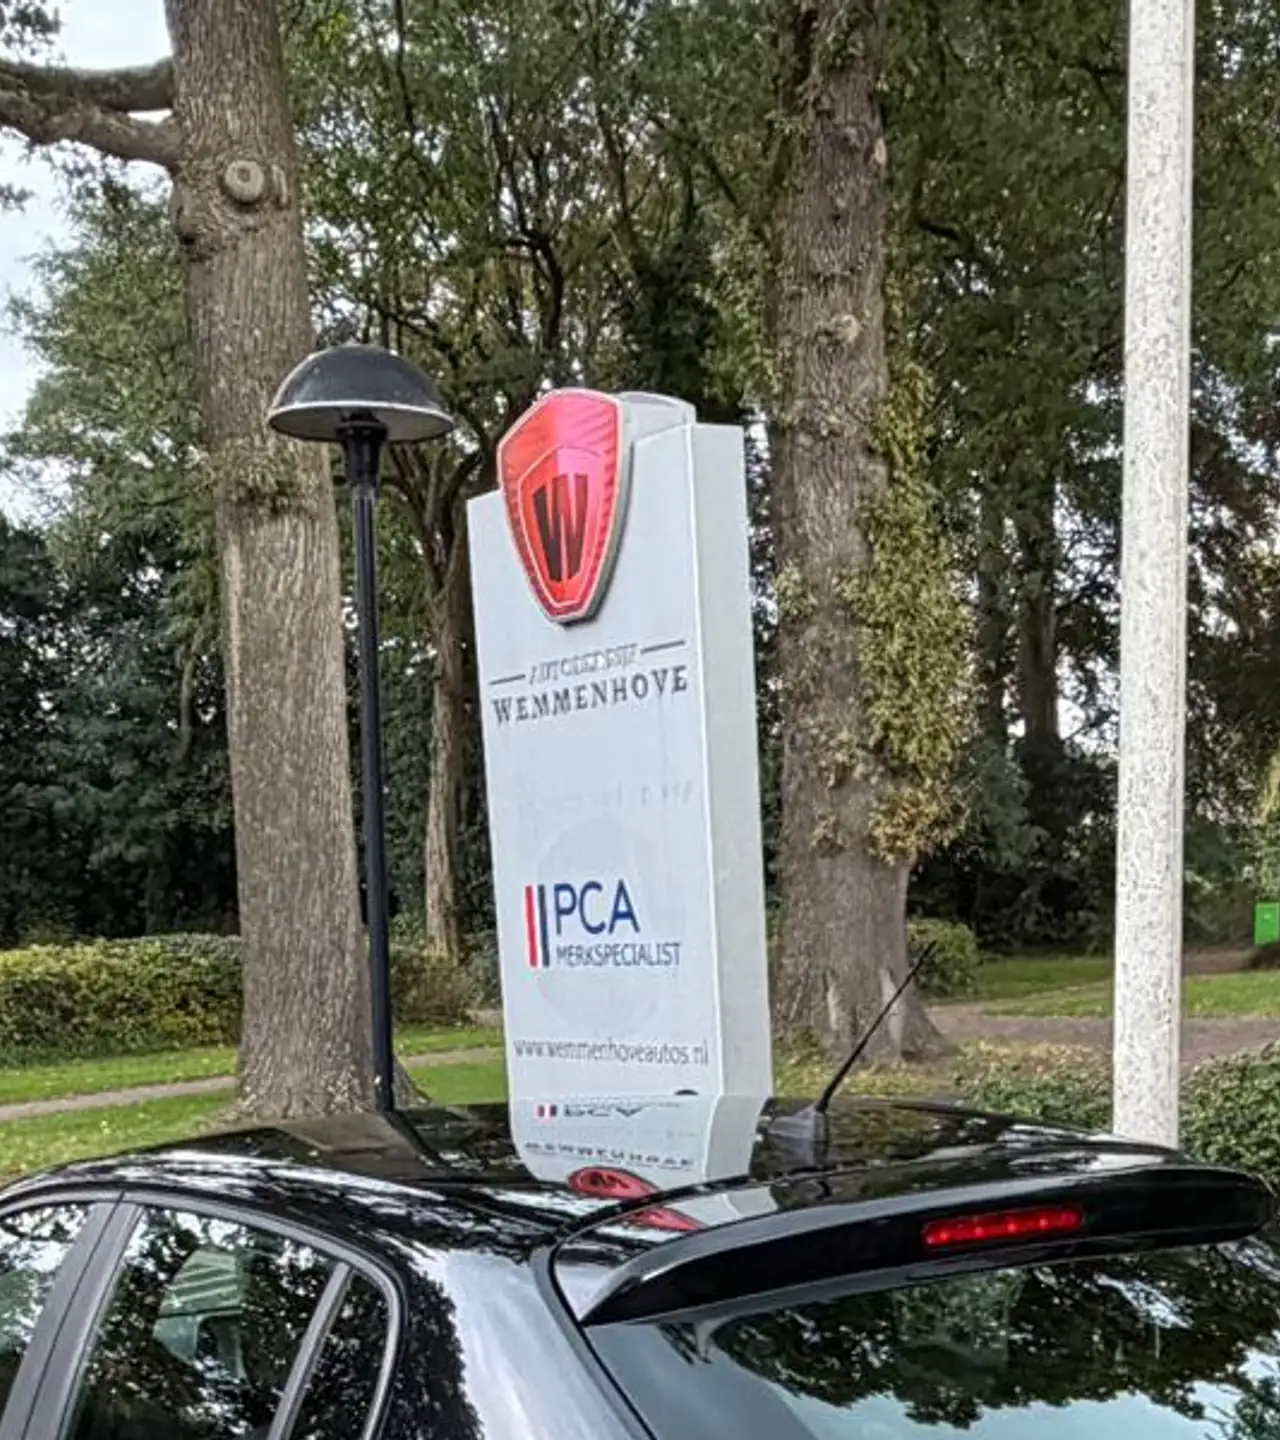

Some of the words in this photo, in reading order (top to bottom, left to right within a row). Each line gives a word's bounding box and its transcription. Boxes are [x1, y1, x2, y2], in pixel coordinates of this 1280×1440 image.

[490, 665, 688, 726] WEMMENHOVE
[553, 878, 641, 936] PCA
[555, 941, 682, 968] MERKSPECIALIST
[512, 1037, 709, 1066] www.wemmenhoveautos.nl
